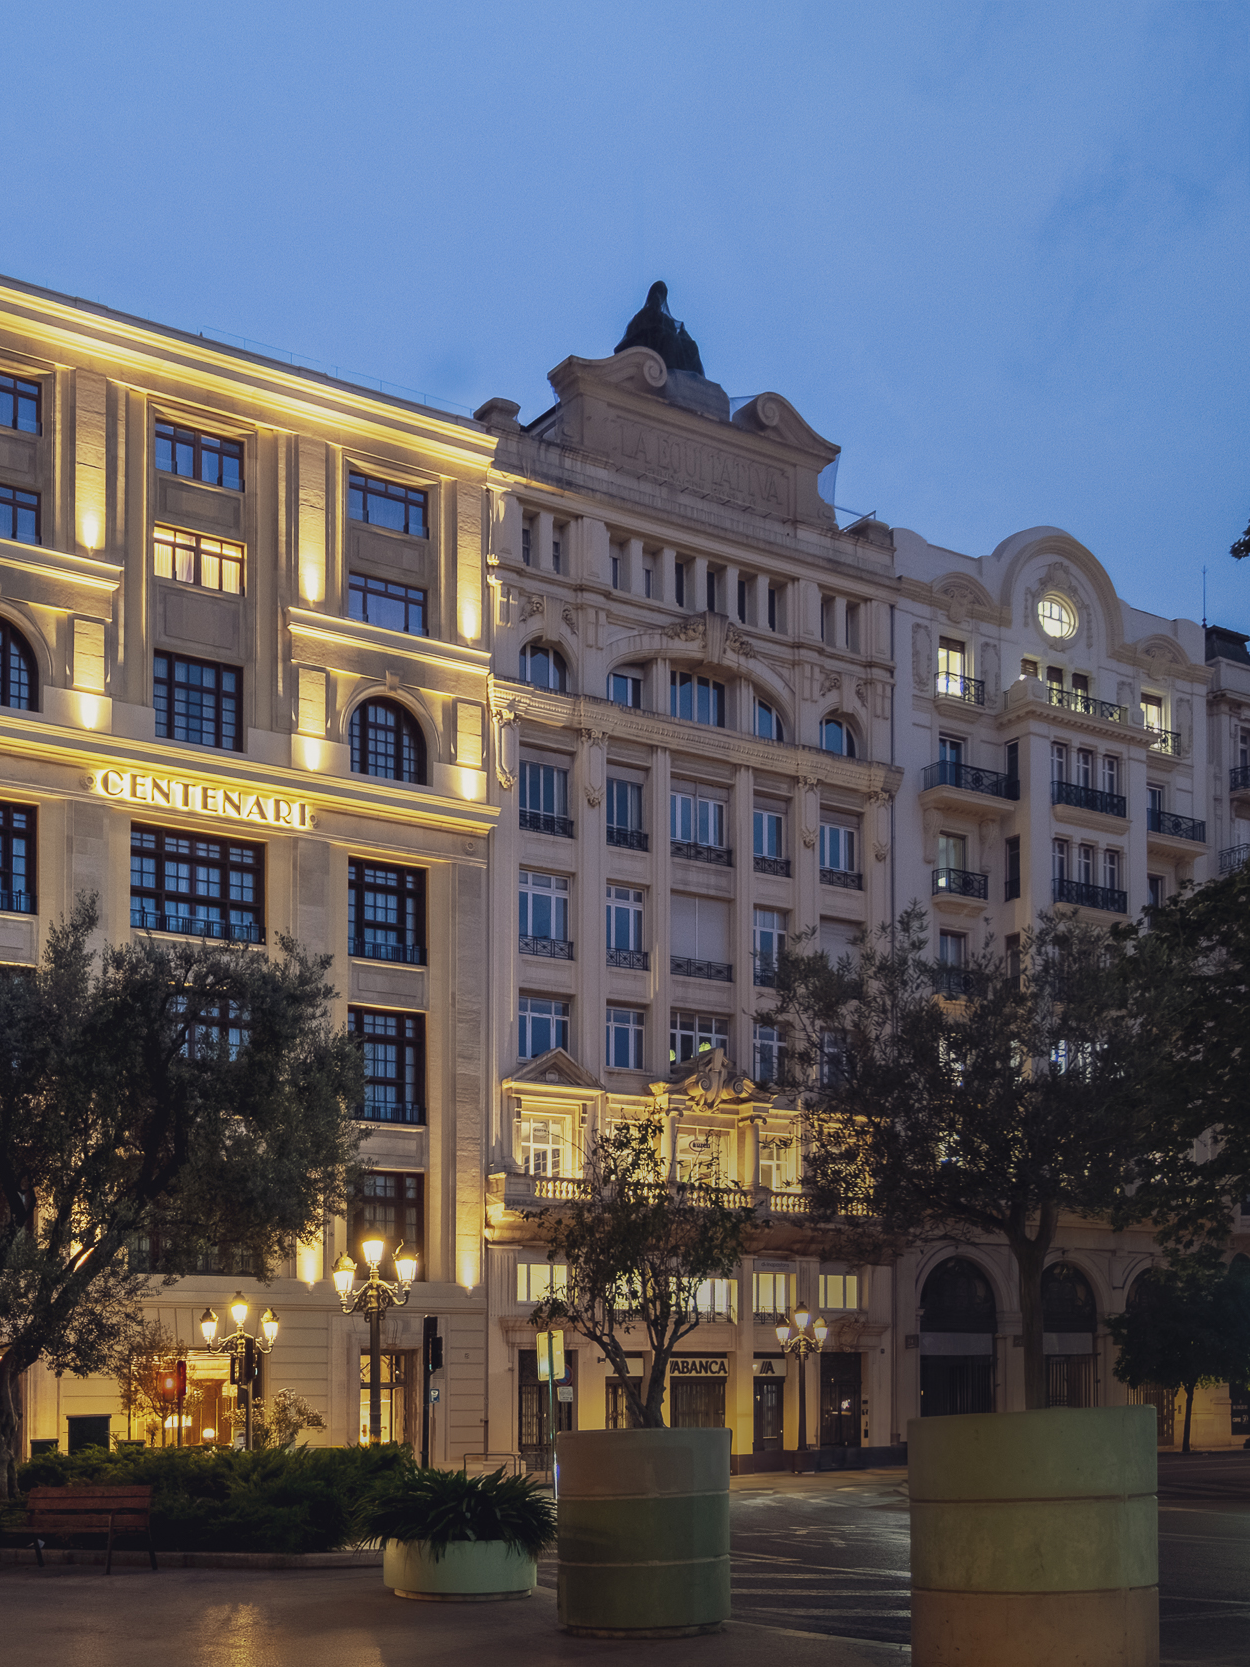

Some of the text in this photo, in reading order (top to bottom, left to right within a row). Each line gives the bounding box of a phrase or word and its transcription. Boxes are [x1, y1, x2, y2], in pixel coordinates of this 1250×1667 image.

[620, 423, 783, 506] LA EQUITATIVA
[100, 769, 307, 827] CENTENARI
[671, 1360, 728, 1375] ABANCA
